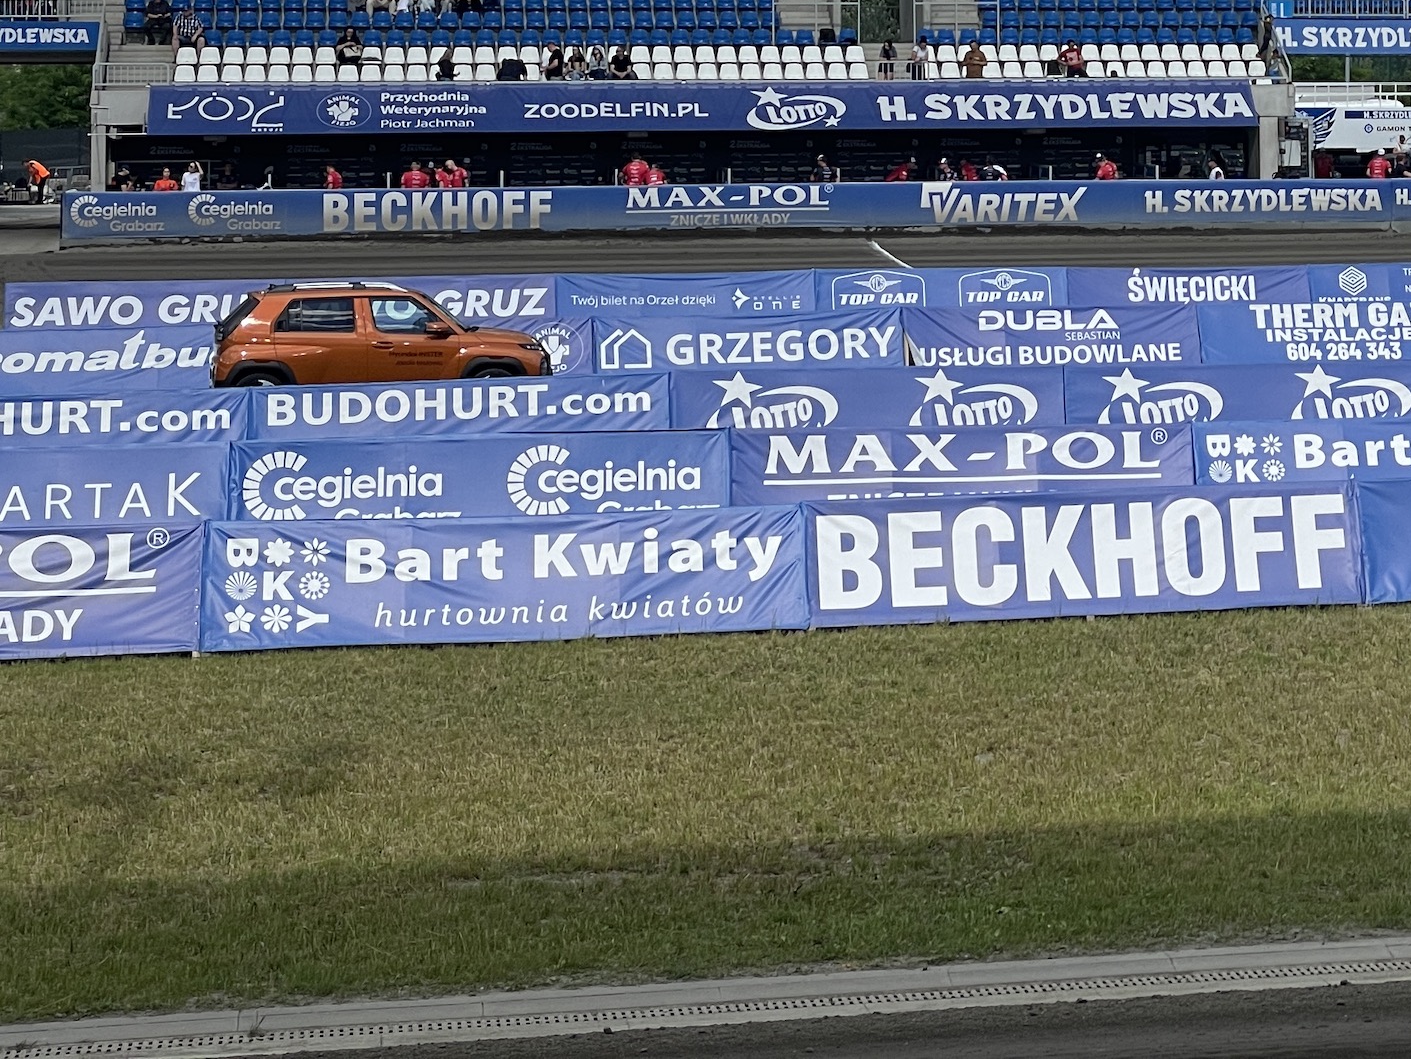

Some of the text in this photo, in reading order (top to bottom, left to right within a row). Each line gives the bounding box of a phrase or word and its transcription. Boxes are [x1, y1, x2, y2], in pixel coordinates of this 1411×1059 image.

[380, 92, 469, 104] Przychodnia
[380, 104, 487, 116] Weterynaryjna
[524, 102, 709, 118] ZOODELFIN.PL
[877, 92, 1254, 121] H. SKRZYDLEWSKA
[380, 118, 475, 128] Piotr Jachman
[766, 100, 827, 124] LOTTO
[627, 185, 829, 208] MAX-POL
[934, 186, 1088, 223] VARITEX
[1145, 188, 1383, 213] H. SKRZYDLEWSKA
[1395, 189, 1411, 205] H.
[322, 190, 554, 232] BECKHOFF
[670, 214, 720, 227] ZNICZE
[732, 212, 791, 226] WKŁADY
[109, 220, 165, 232] Grabarz
[226, 218, 281, 230] Grabarz
[966, 291, 1044, 303] TOP CAR
[1127, 268, 1256, 304] ŚWIĘCICKI
[10, 294, 143, 327] SAWO
[433, 287, 548, 317] GRUZ
[571, 293, 716, 308] Twój bilet na Orzeł dzięki
[839, 293, 919, 305] TOP CAR
[978, 309, 1119, 331] DUBLA
[1249, 302, 1360, 329] THERM
[535, 327, 571, 340] ANIMAL
[1065, 331, 1121, 341] SEBASTIAN
[666, 326, 896, 366] GRZEGORY
[922, 343, 1182, 367] USŁUGI BUDOWLANE
[1286, 342, 1402, 361] 604 264 343
[267, 384, 651, 427] BUDOHURT.com
[763, 431, 1161, 475] MAX-POL
[1294, 433, 1411, 469] Bart
[343, 526, 783, 585] Bart Kwiaty
[815, 494, 1346, 611] BECKHOFF
[374, 592, 745, 629] hurtownia kwiatów
